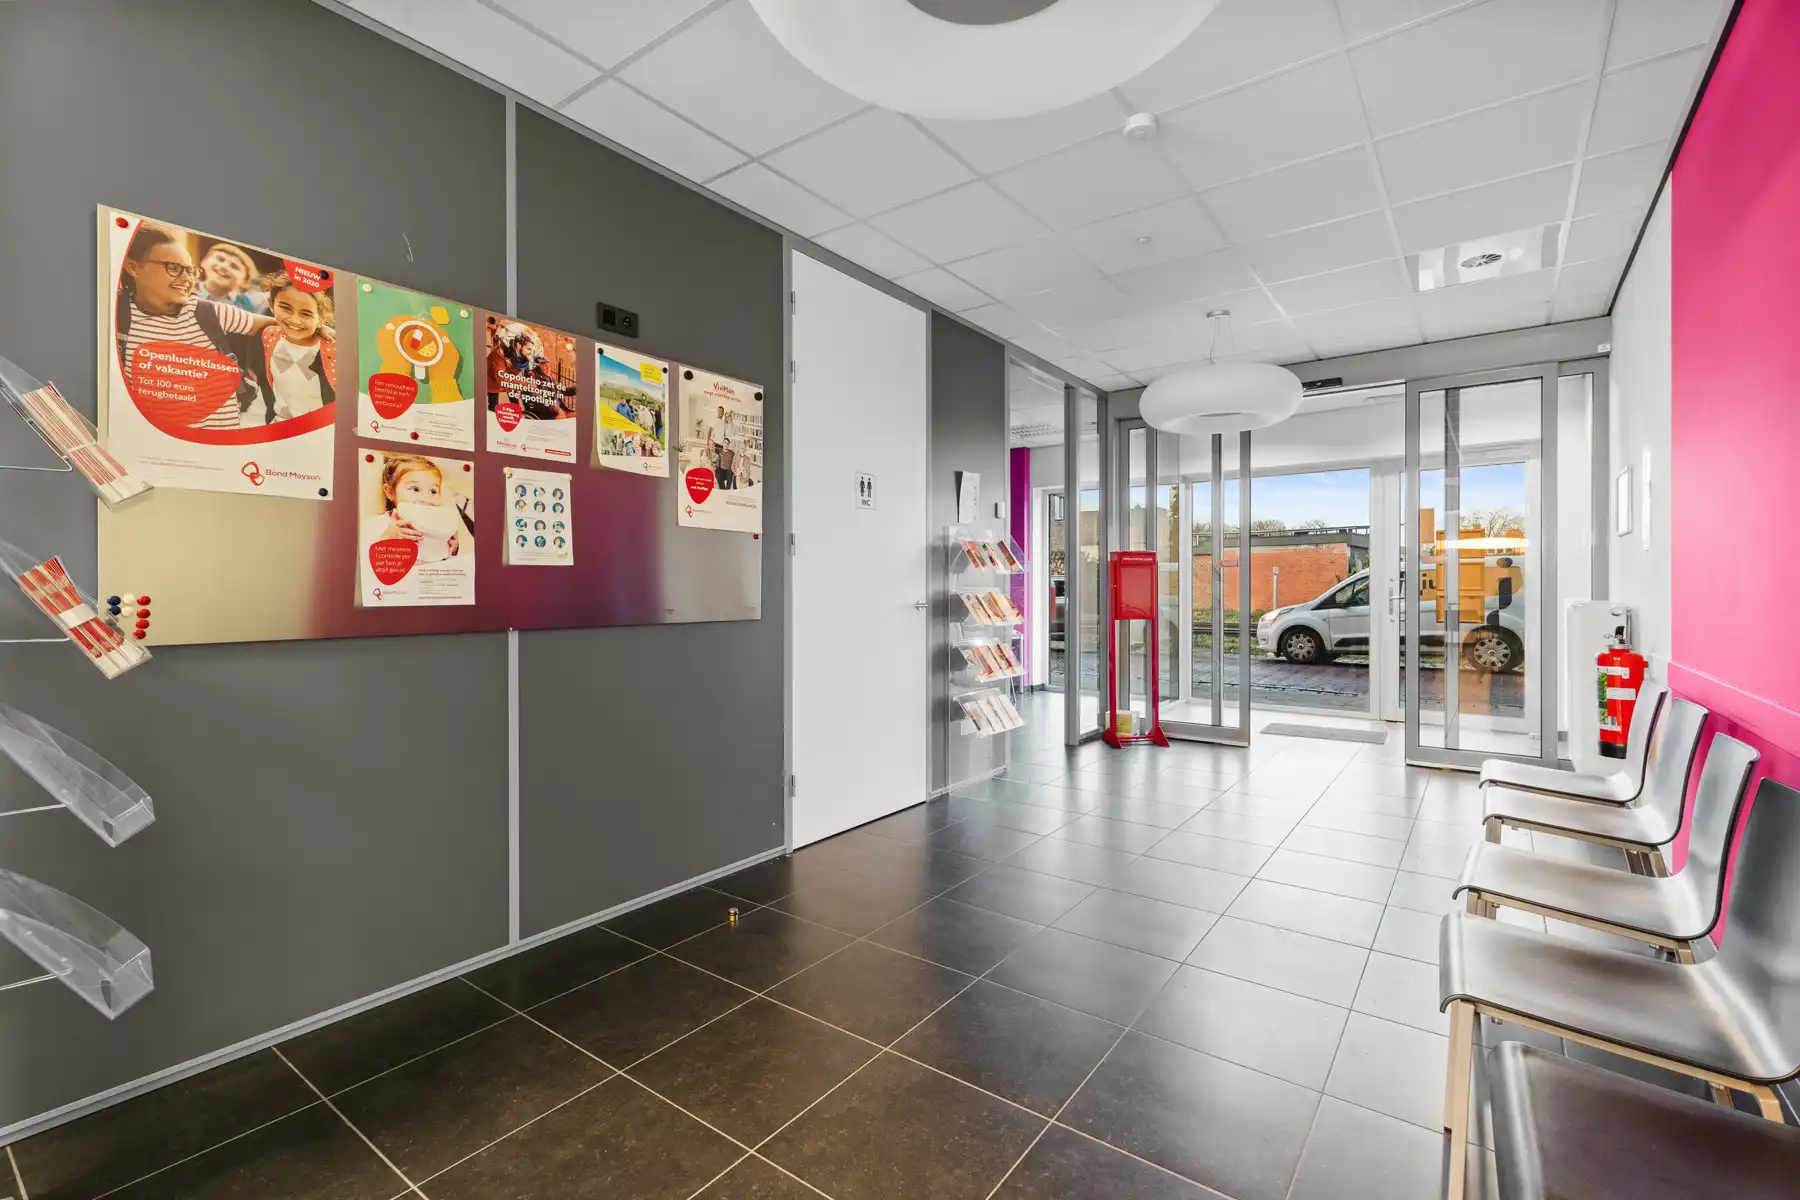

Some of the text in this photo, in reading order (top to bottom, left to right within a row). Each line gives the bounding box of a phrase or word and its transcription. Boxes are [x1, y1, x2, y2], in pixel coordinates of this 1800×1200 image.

[295, 266, 321, 281] NIEUW
[302, 277, 320, 288] 2020
[139, 348, 239, 373] Openluchtklassen
[138, 361, 208, 379] of vakantie?
[138, 376, 195, 392] Tot 100 euro
[385, 383, 415, 392] verkoudheid
[497, 369, 567, 391] Coponcho zet de
[713, 381, 735, 394] ViviPlan
[138, 387, 197, 403] terugbetaald
[500, 380, 564, 400] mantelzorger in
[508, 389, 558, 407] de spotlight
[265, 468, 321, 481] Bond Moyson
[861, 499, 871, 507] WC
